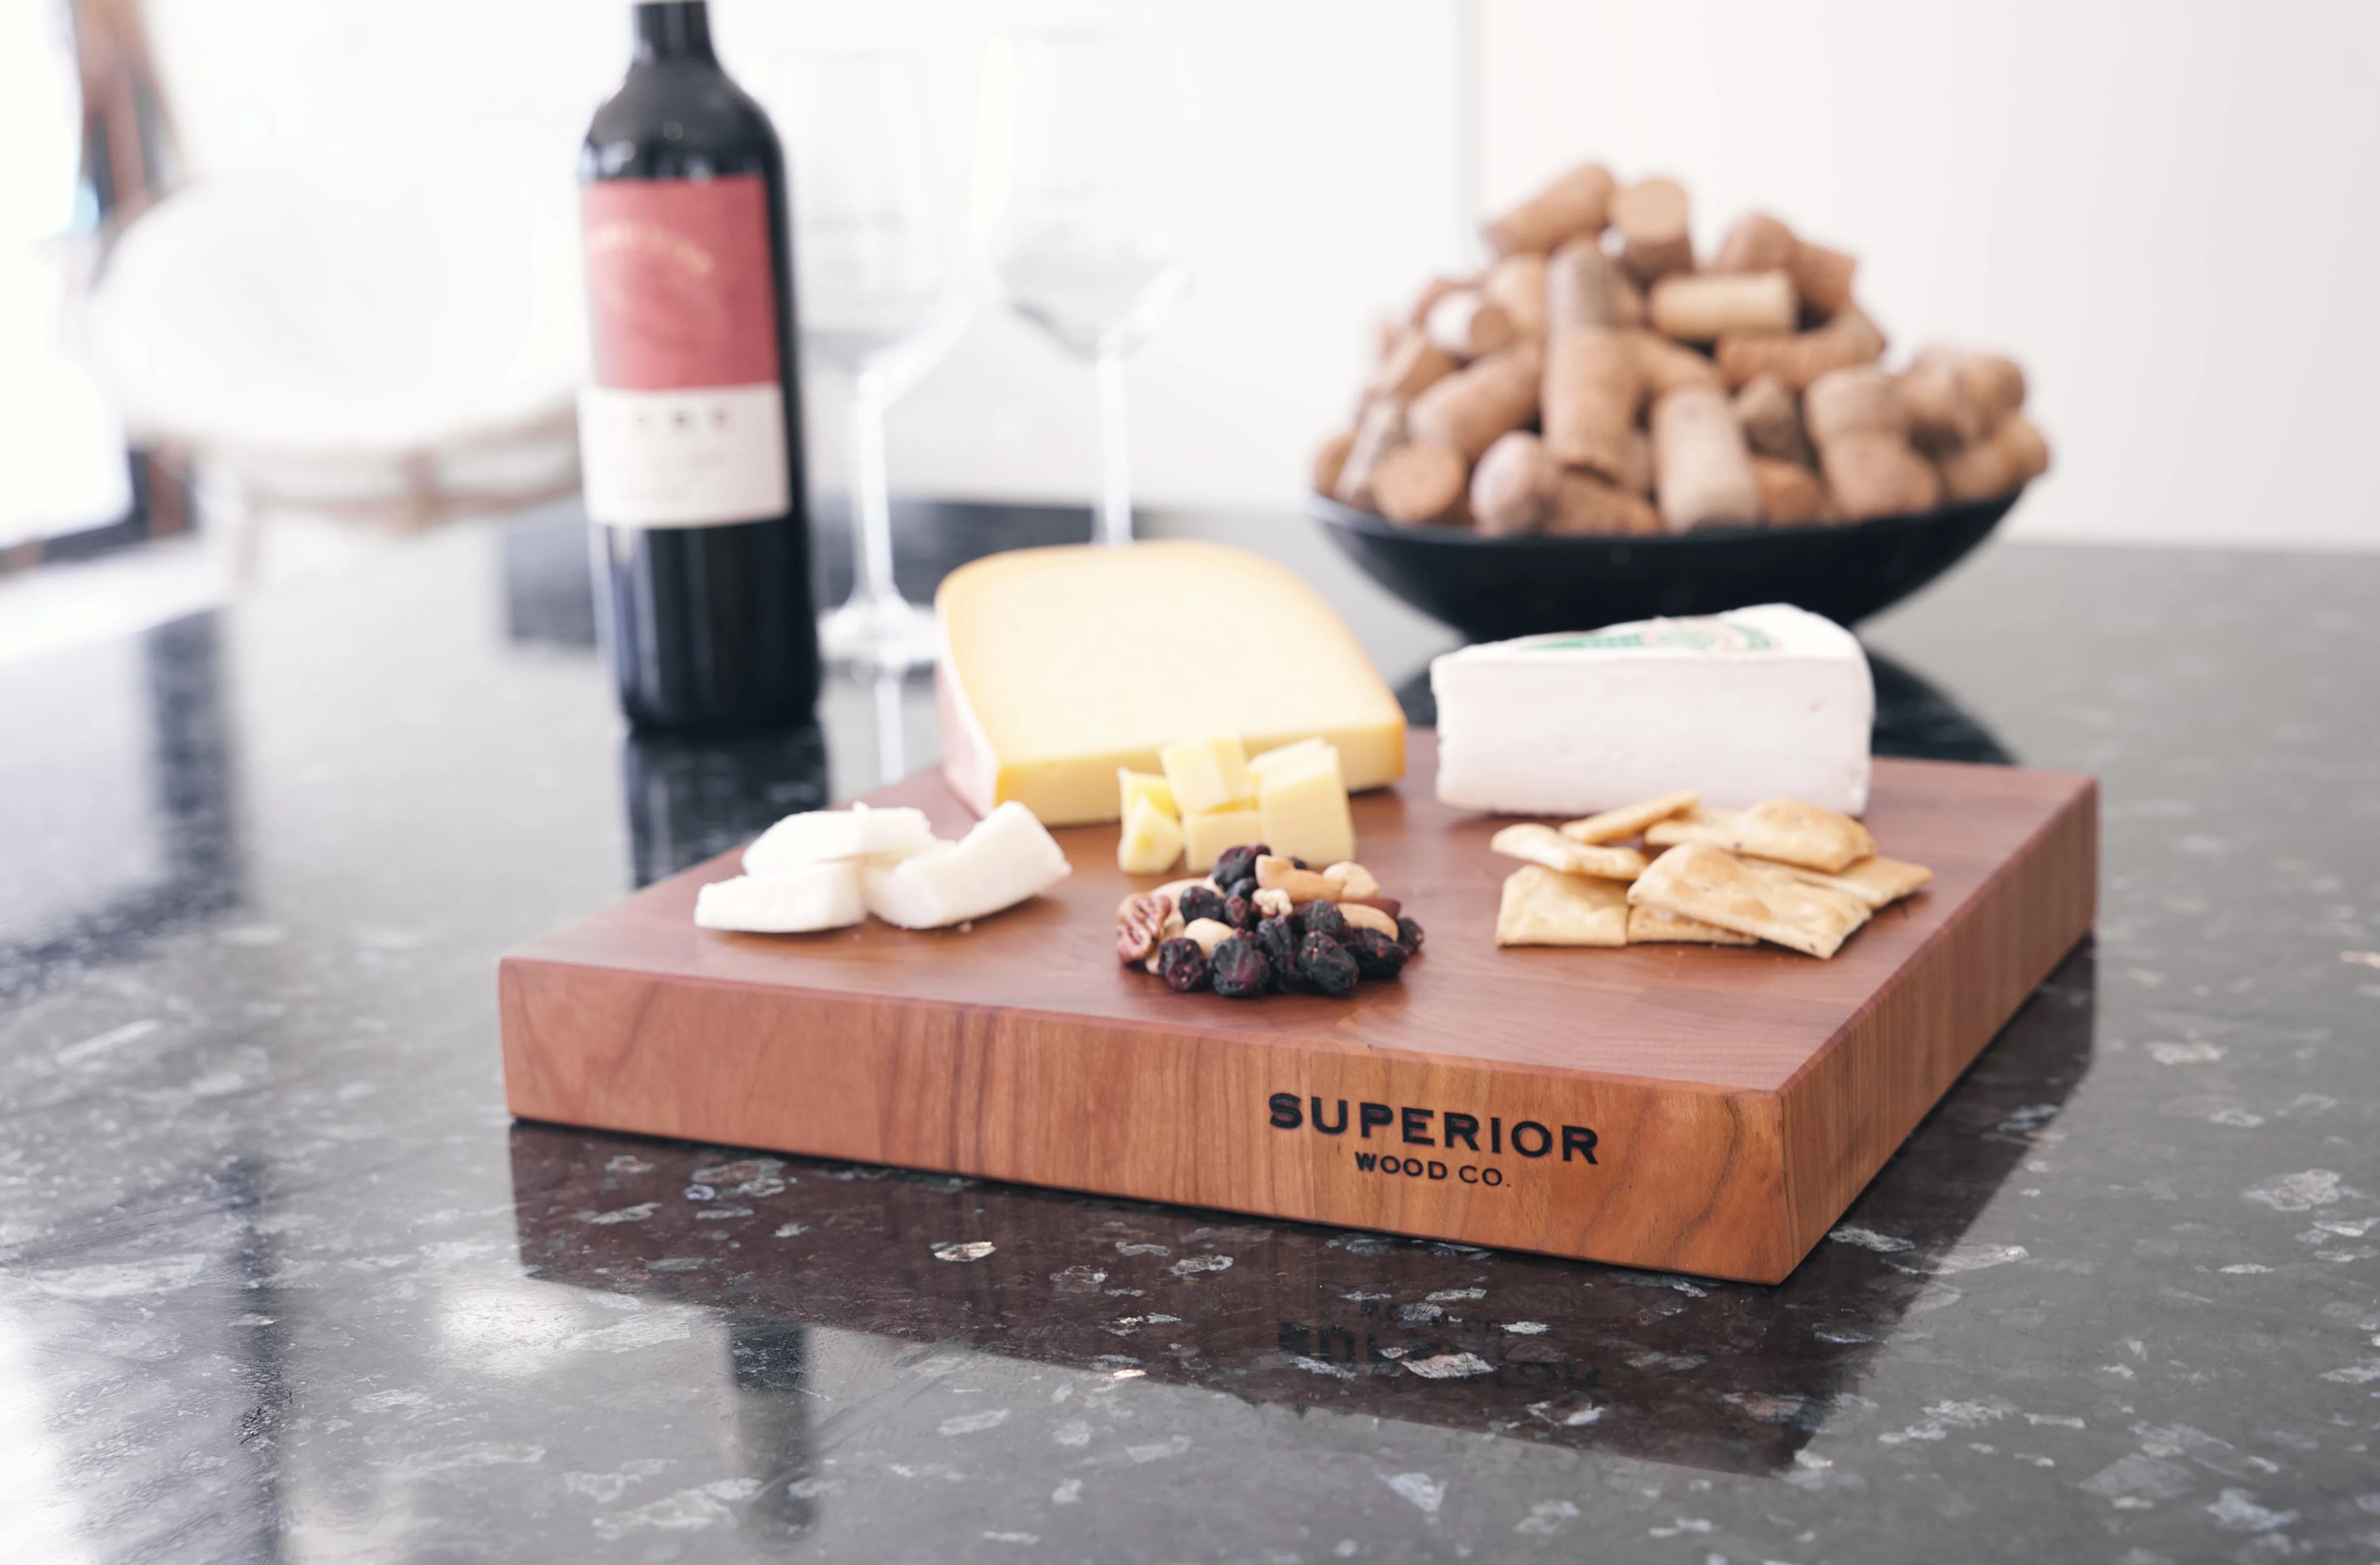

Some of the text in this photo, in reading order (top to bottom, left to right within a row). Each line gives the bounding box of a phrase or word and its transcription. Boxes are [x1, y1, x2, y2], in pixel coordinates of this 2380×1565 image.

[1268, 1092, 1599, 1165] SUPERIOR
[1354, 1151, 1511, 1187] WOOD CO.
